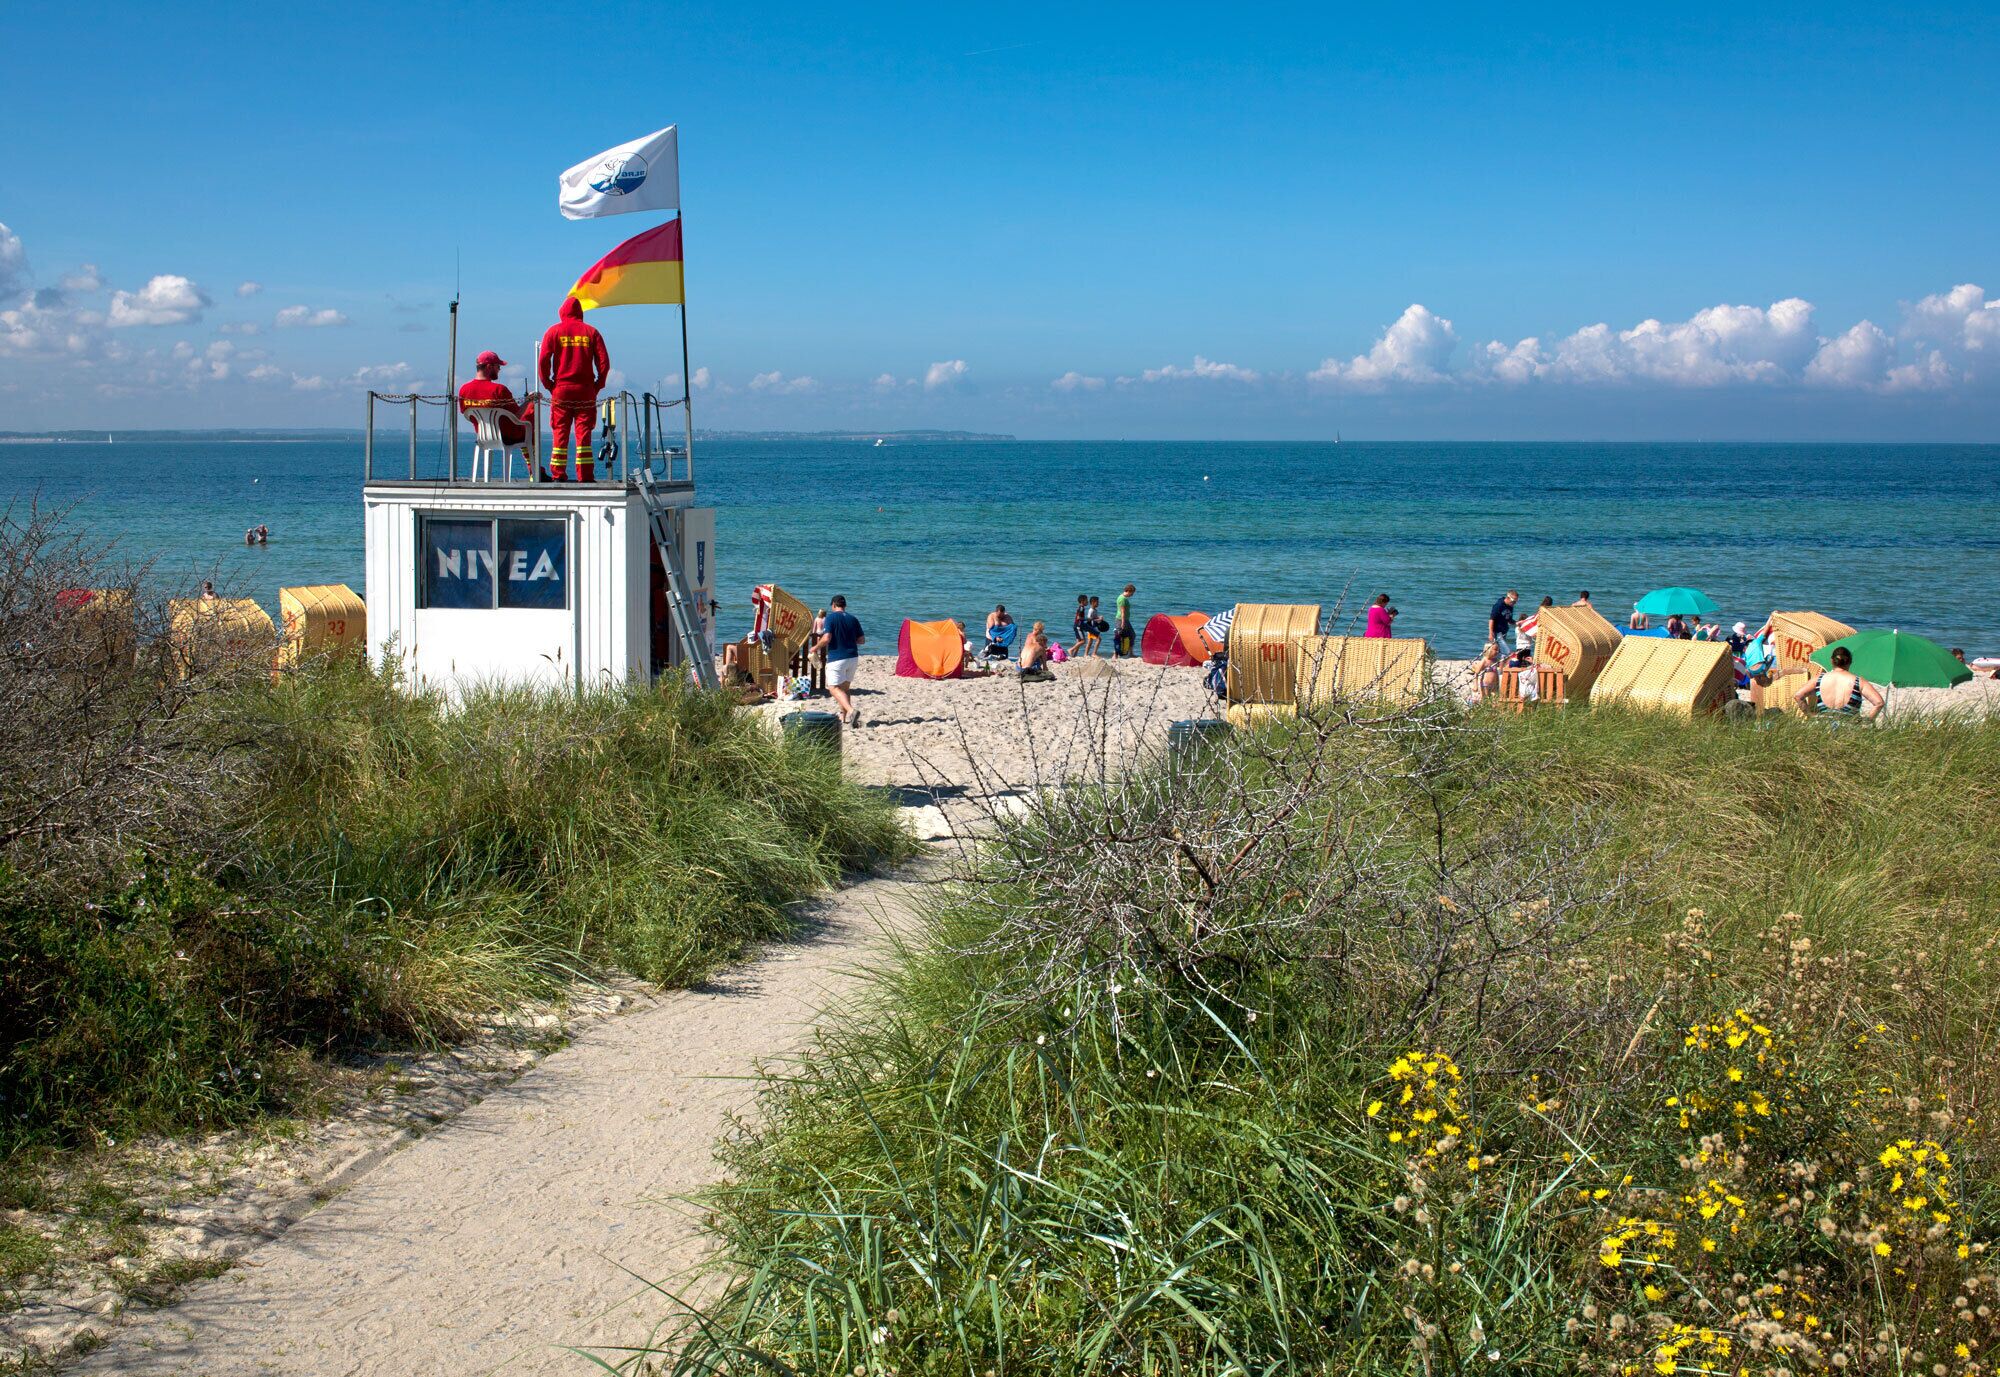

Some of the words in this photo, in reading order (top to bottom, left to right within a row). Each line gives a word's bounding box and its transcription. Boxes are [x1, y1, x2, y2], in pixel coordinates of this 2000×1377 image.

[560, 335, 590, 343] DLRG
[437, 547, 560, 581] NIVEA
[327, 619, 346, 636] 33
[1260, 641, 1285, 663] 101
[1544, 635, 1570, 666] 102
[1785, 637, 1814, 664] 103
